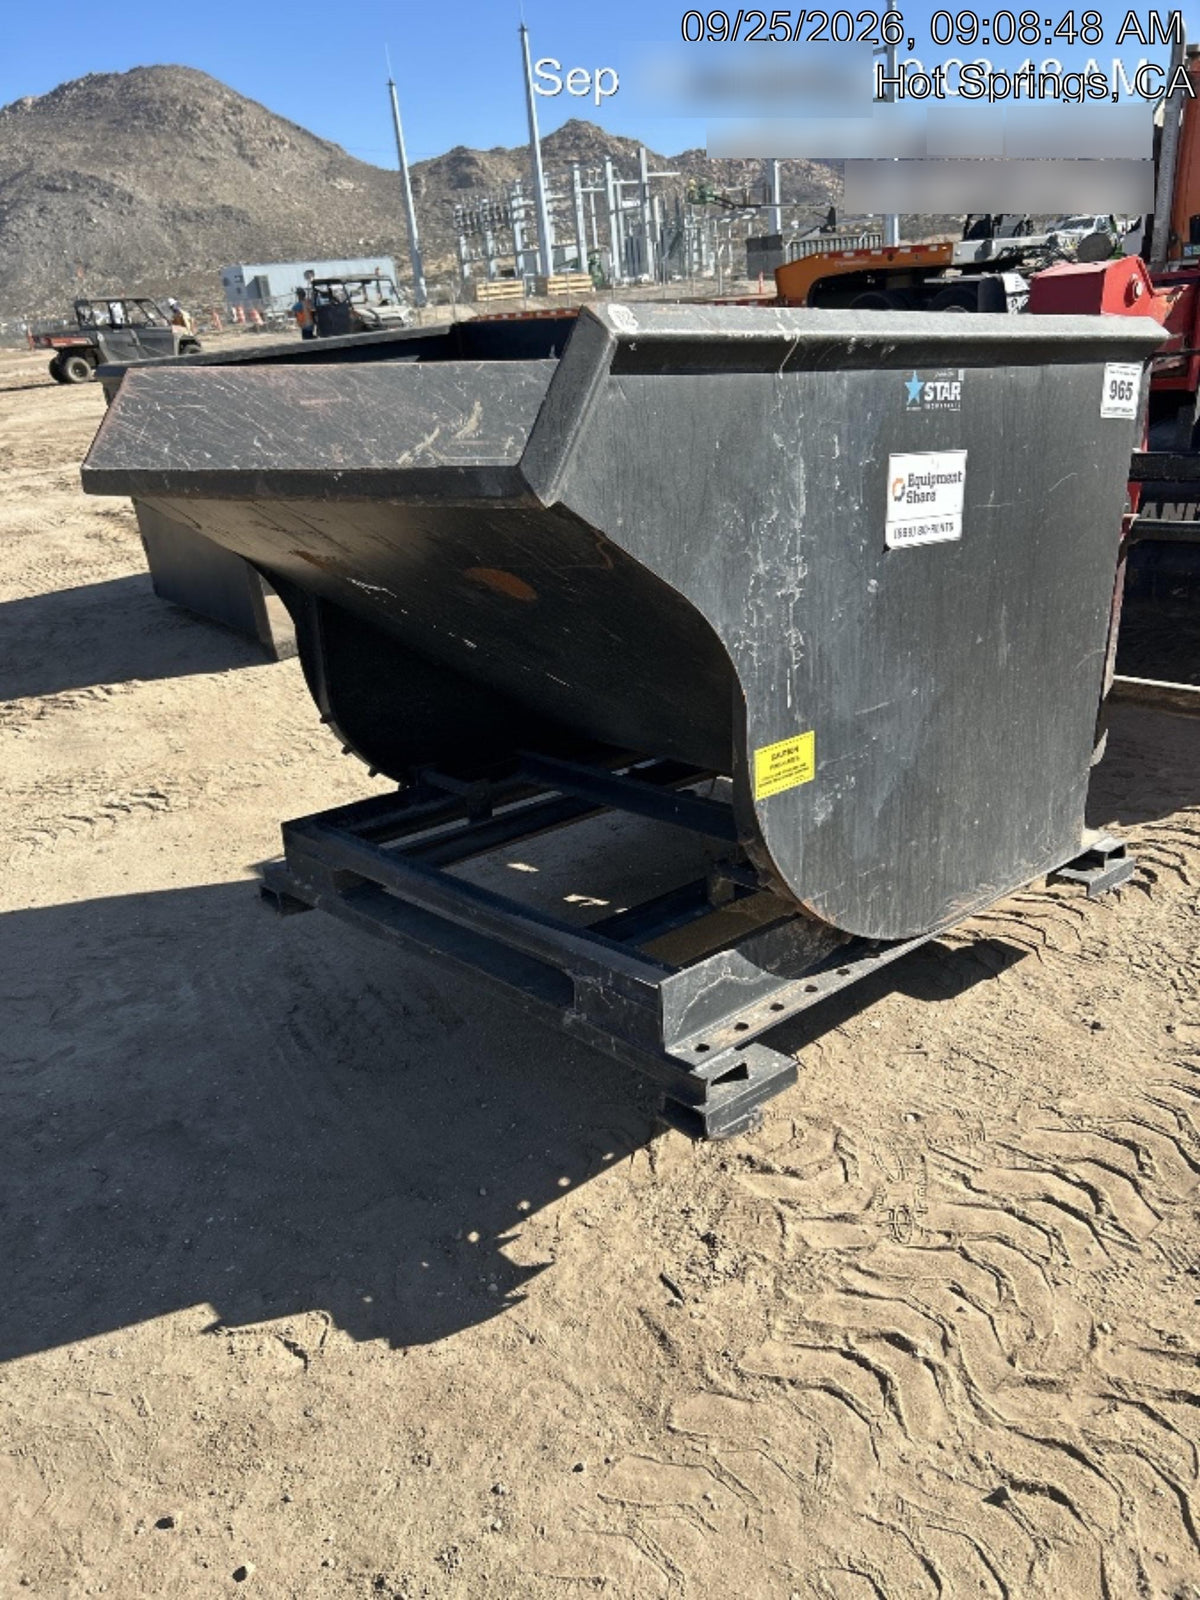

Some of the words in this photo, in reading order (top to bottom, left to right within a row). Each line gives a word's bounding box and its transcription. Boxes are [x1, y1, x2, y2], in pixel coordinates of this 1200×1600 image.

[924, 381, 961, 401] STAR
[1109, 379, 1134, 401] 965
[907, 470, 963, 490] Equipment
[906, 490, 937, 504] Share
